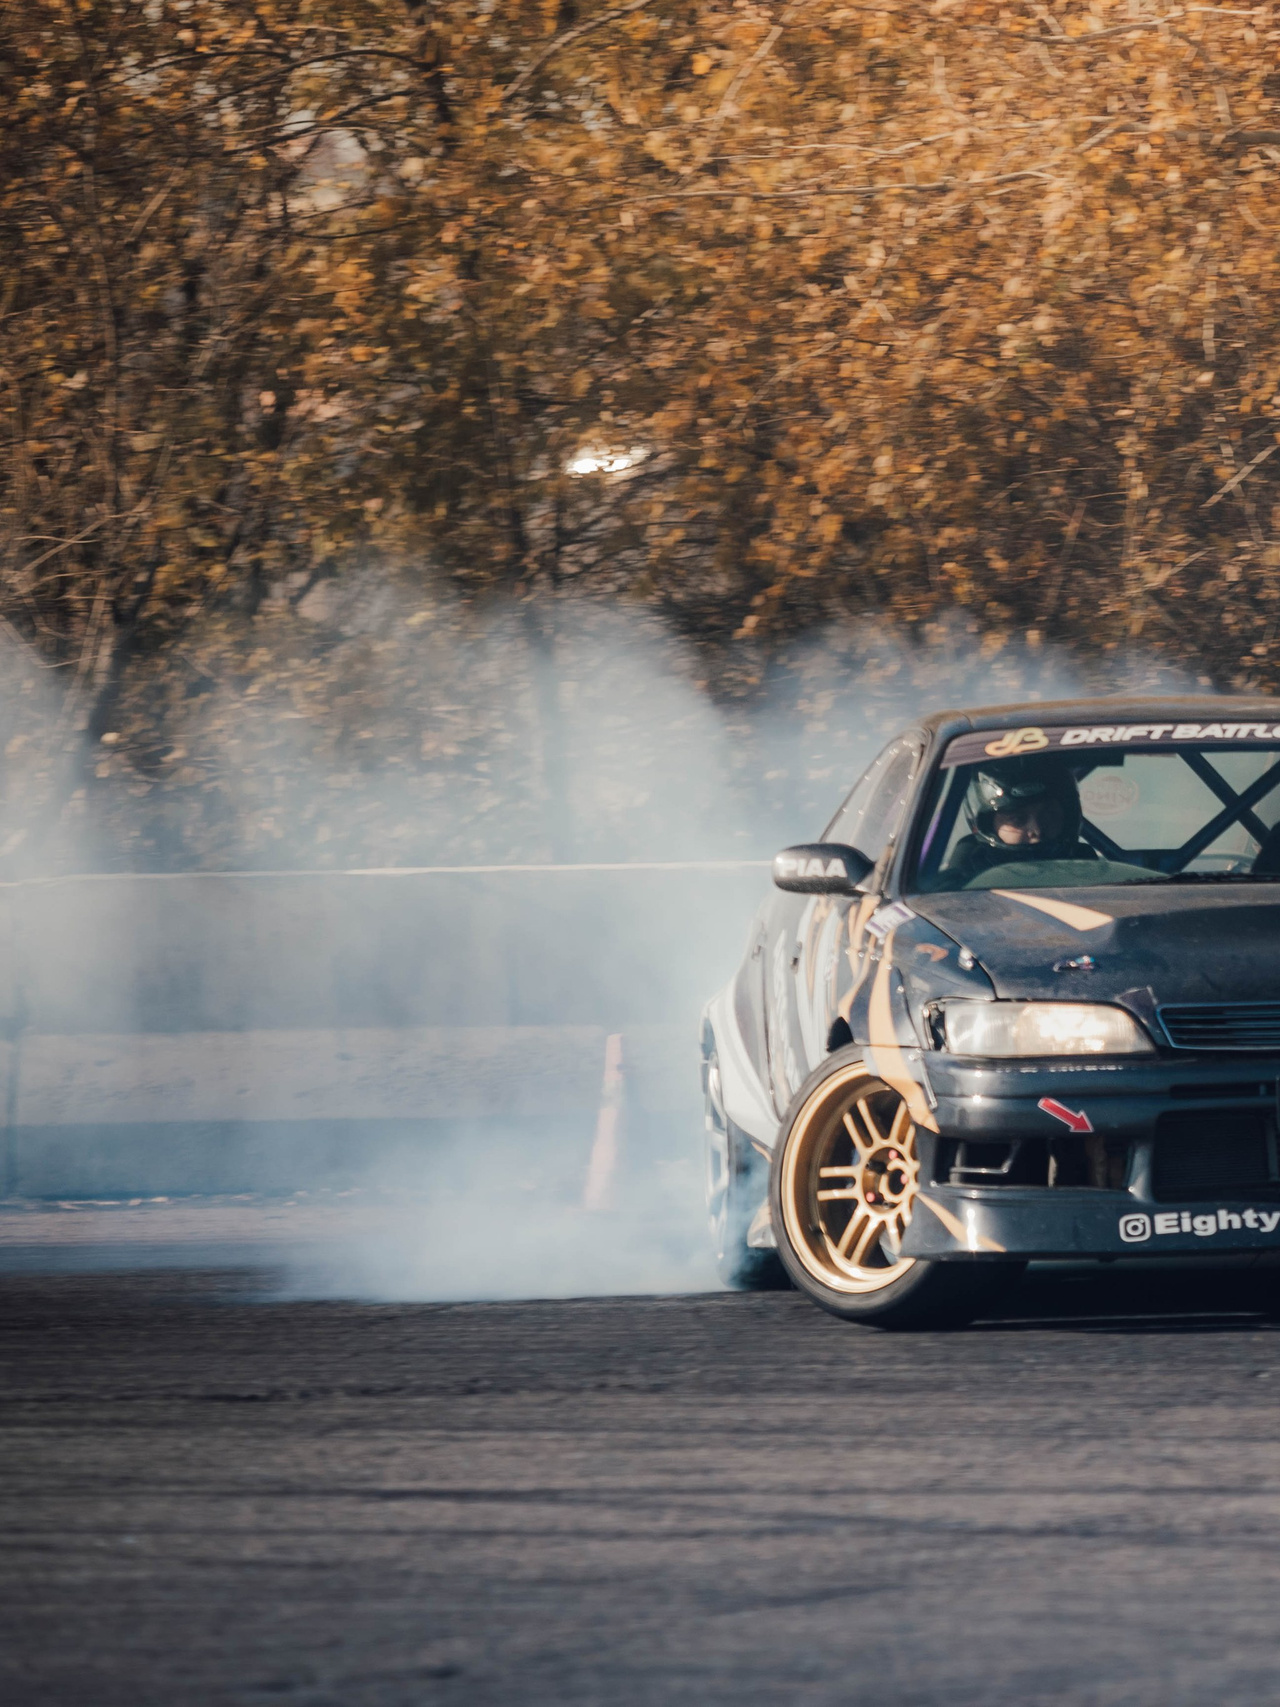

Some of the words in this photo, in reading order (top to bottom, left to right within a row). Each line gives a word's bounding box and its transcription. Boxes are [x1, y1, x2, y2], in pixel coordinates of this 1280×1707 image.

[1060, 725, 1173, 744] DRIFT
[779, 858, 847, 877] PIAA
[1154, 1208, 1280, 1236] Eighty
